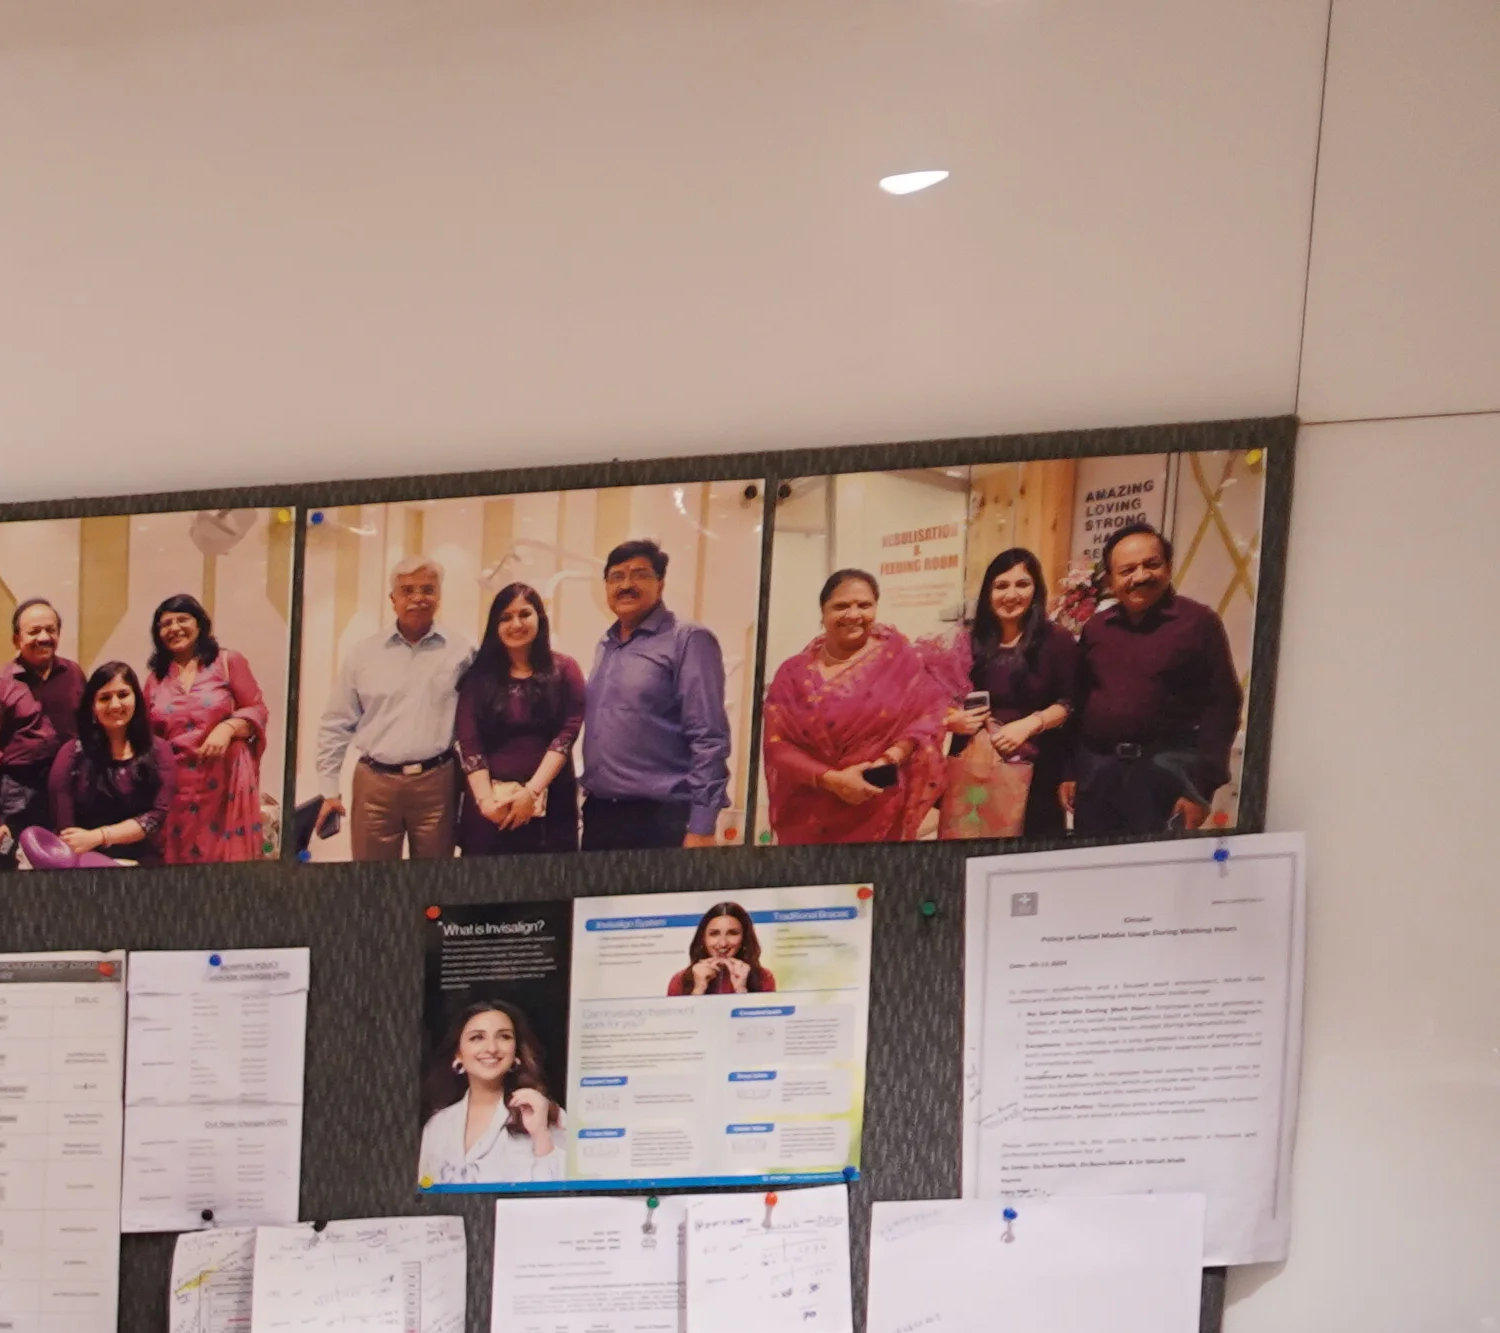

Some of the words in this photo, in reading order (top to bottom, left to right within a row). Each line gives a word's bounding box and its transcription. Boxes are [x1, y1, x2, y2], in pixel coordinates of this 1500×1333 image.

[1086, 480, 1154, 502] AMAZING
[1086, 499, 1141, 517] LOVING
[1085, 513, 1146, 531] STRONG
[443, 922, 473, 937] What
[476, 923, 484, 935] is
[486, 919, 545, 936] Invisalign?
